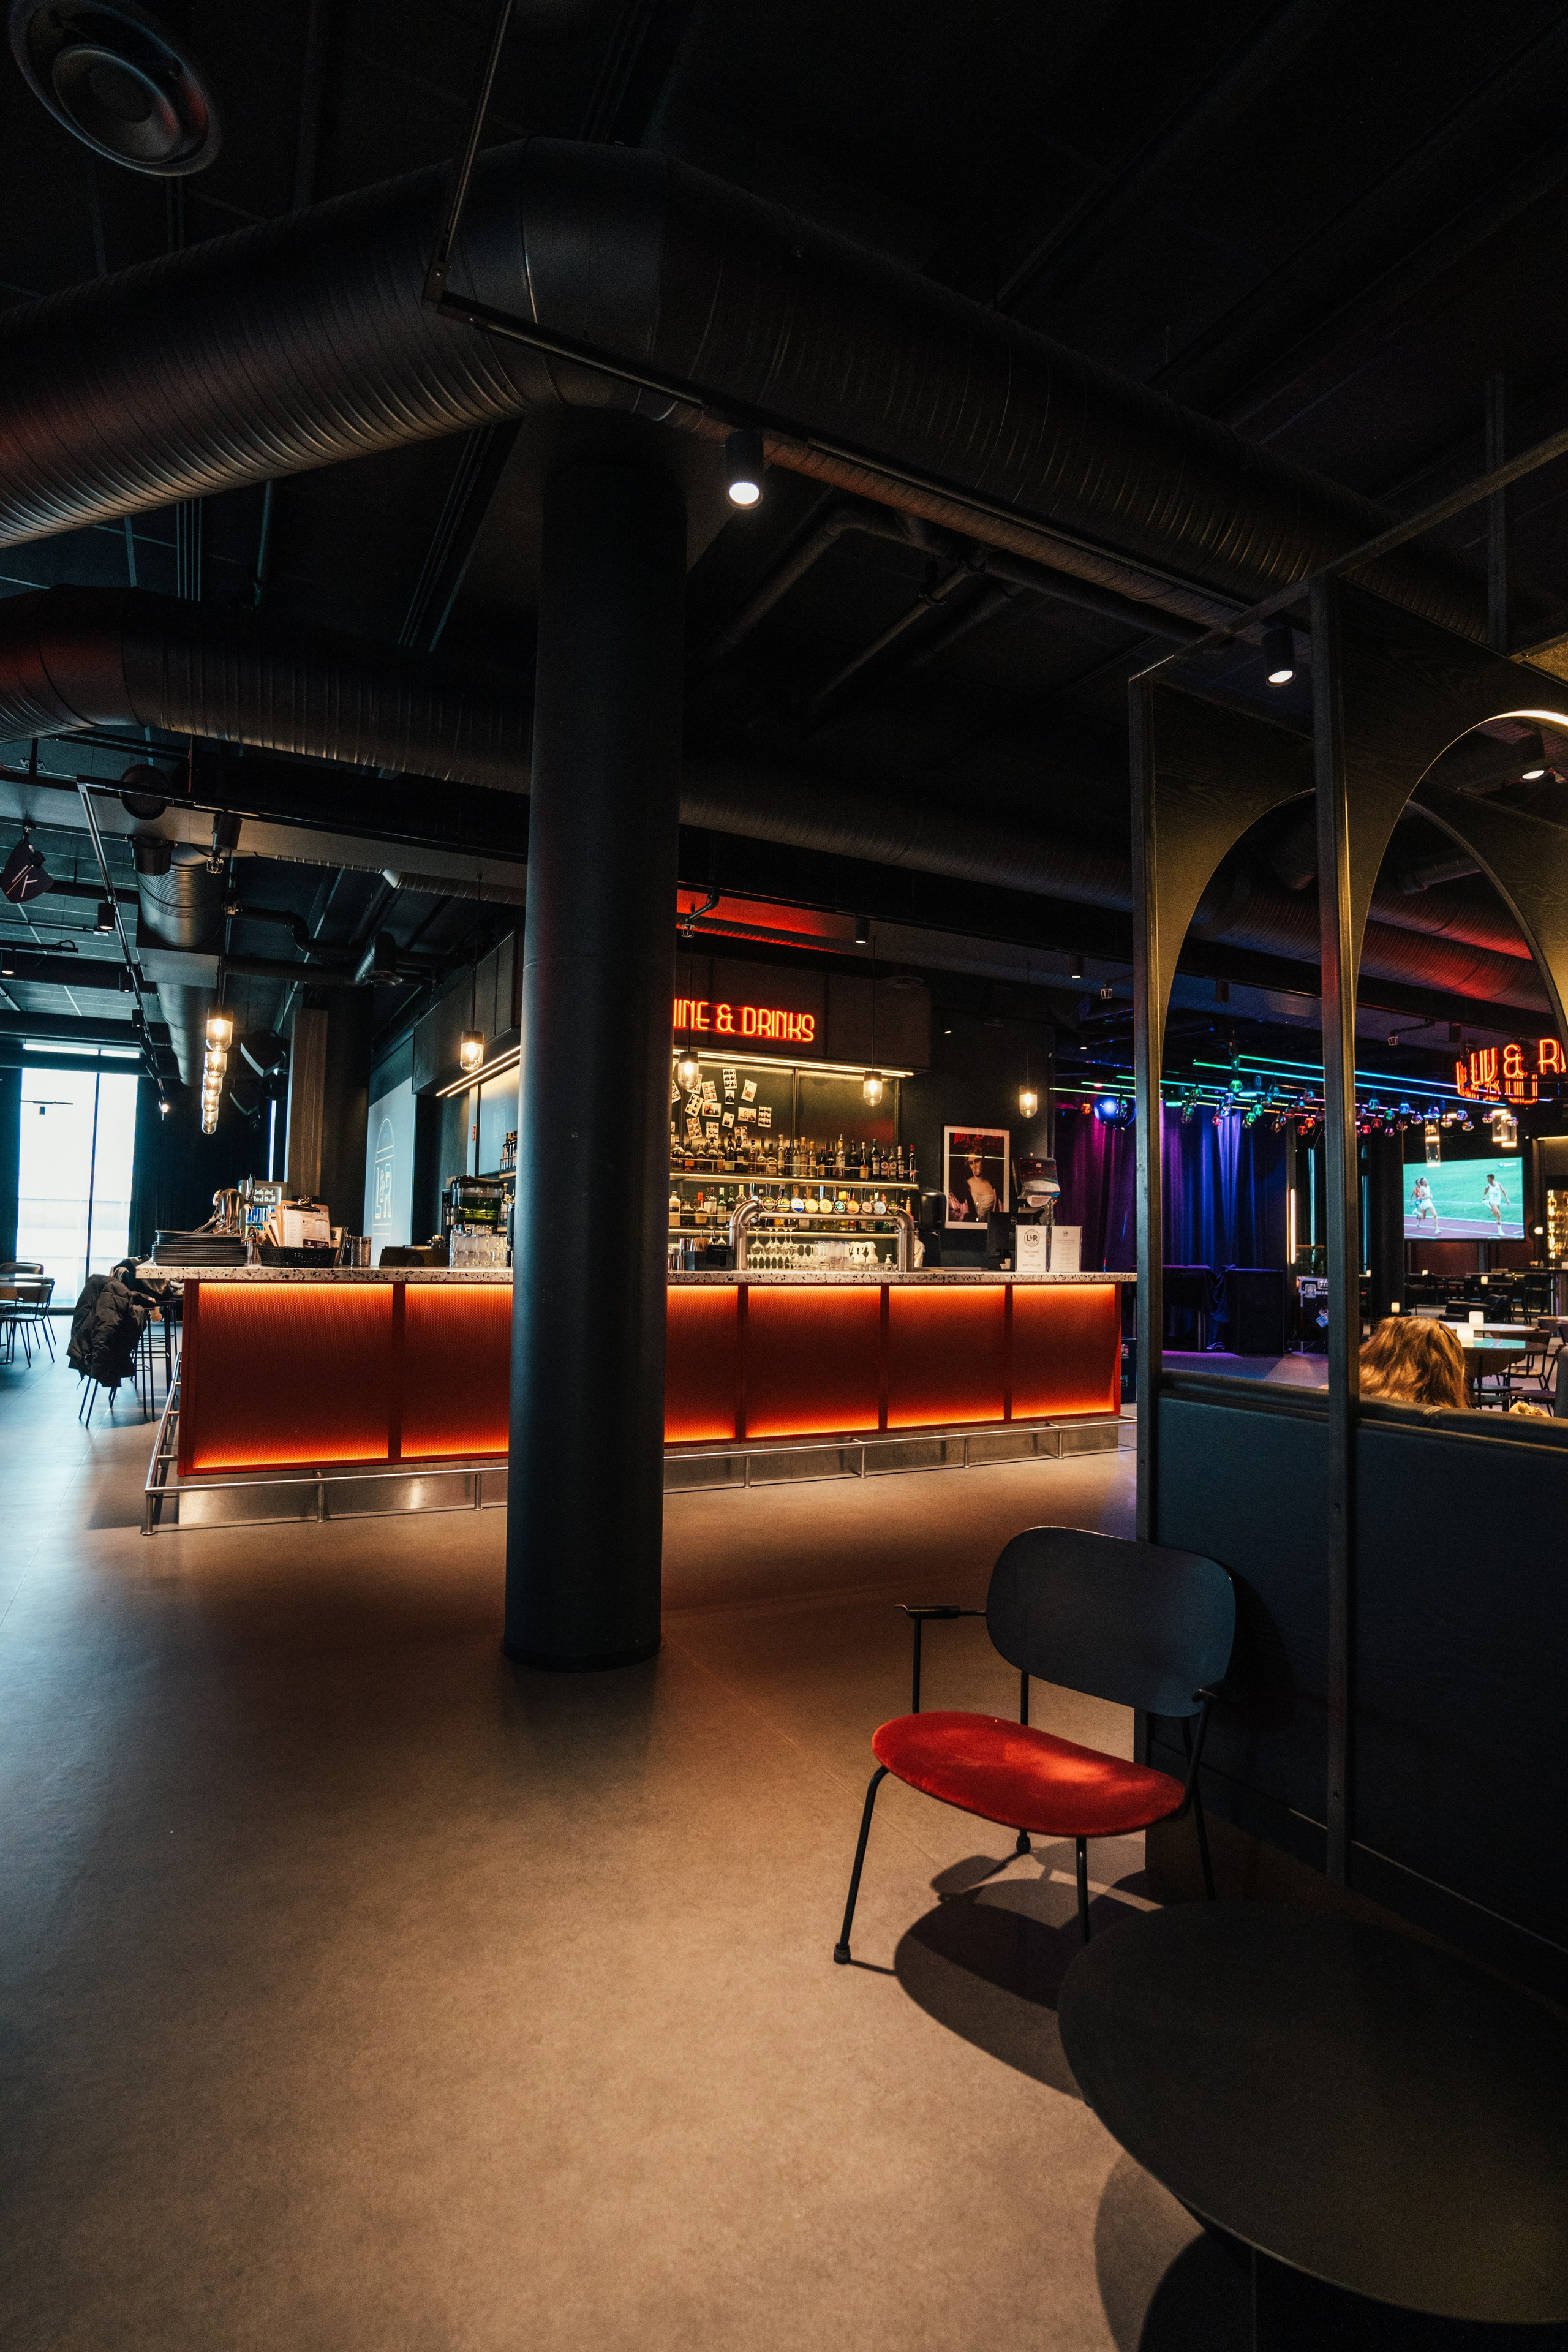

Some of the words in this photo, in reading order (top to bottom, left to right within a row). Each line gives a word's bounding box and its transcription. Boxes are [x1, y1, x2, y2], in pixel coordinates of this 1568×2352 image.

[673, 999, 710, 1030] INE
[717, 1004, 735, 1033] &
[743, 1006, 815, 1041] DRINKS
[1503, 1044, 1527, 1077] &
